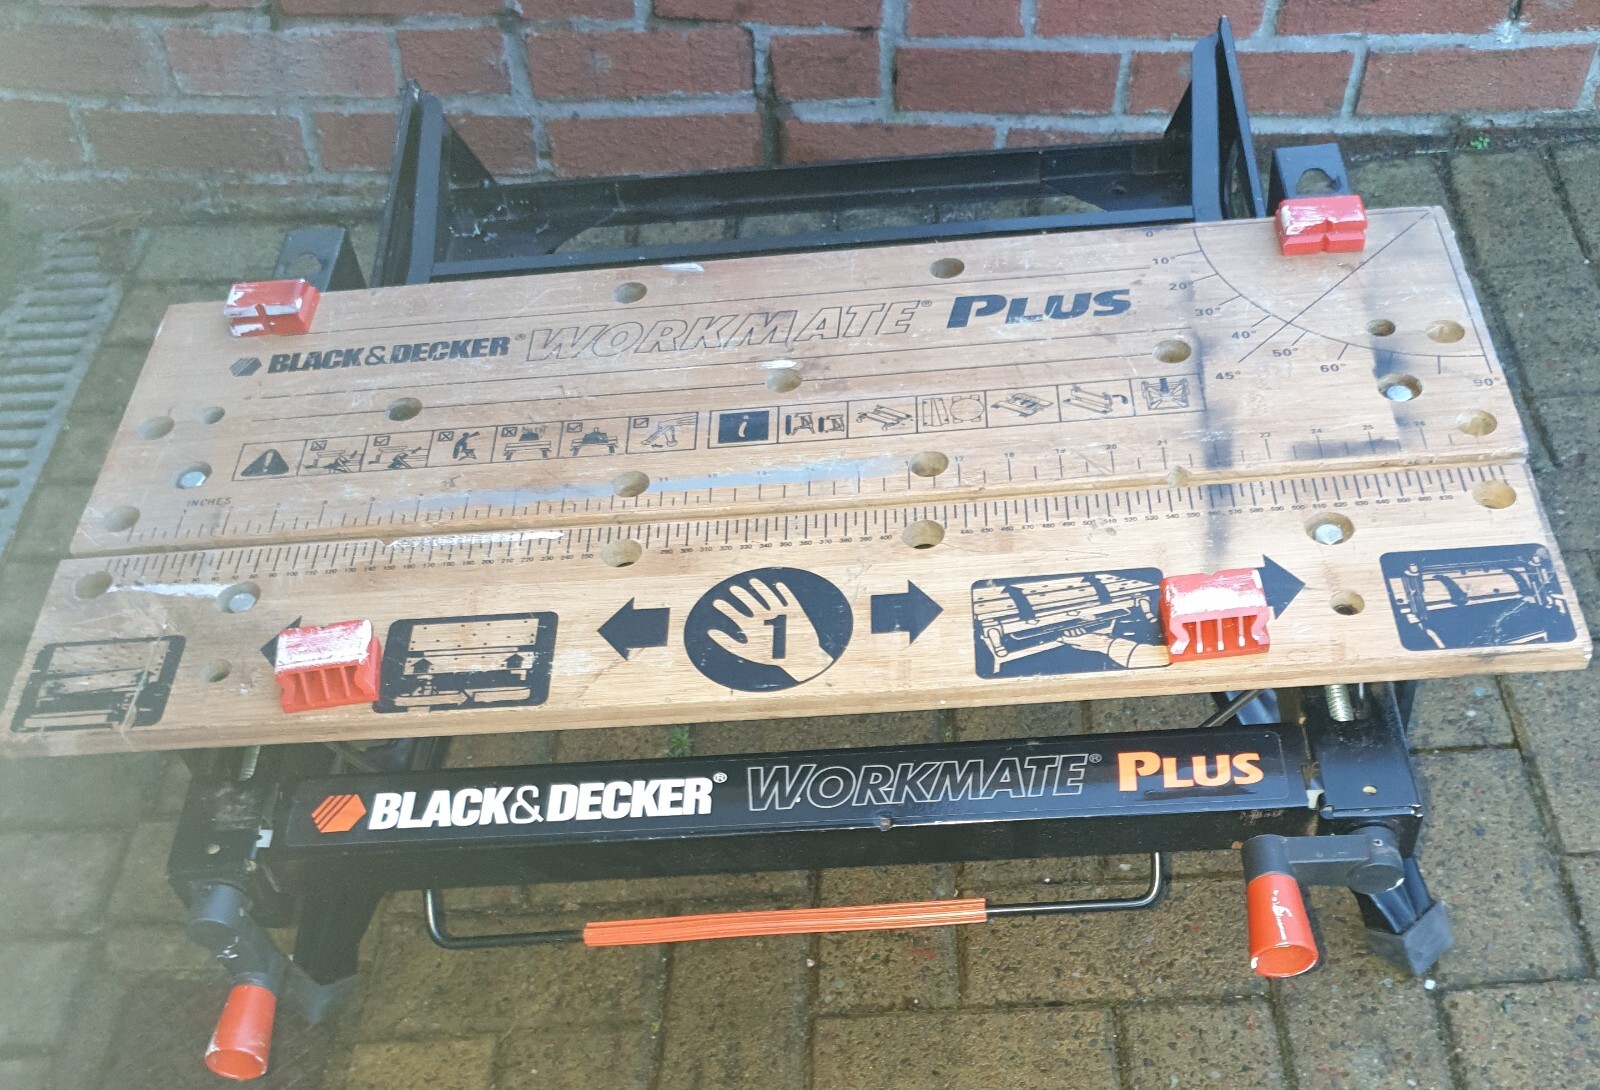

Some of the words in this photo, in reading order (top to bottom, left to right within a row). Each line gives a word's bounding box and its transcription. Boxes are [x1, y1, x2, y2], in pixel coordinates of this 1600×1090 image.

[946, 288, 1132, 329] PLUS
[764, 614, 787, 660] 1
[1117, 751, 1264, 792] PLUS
